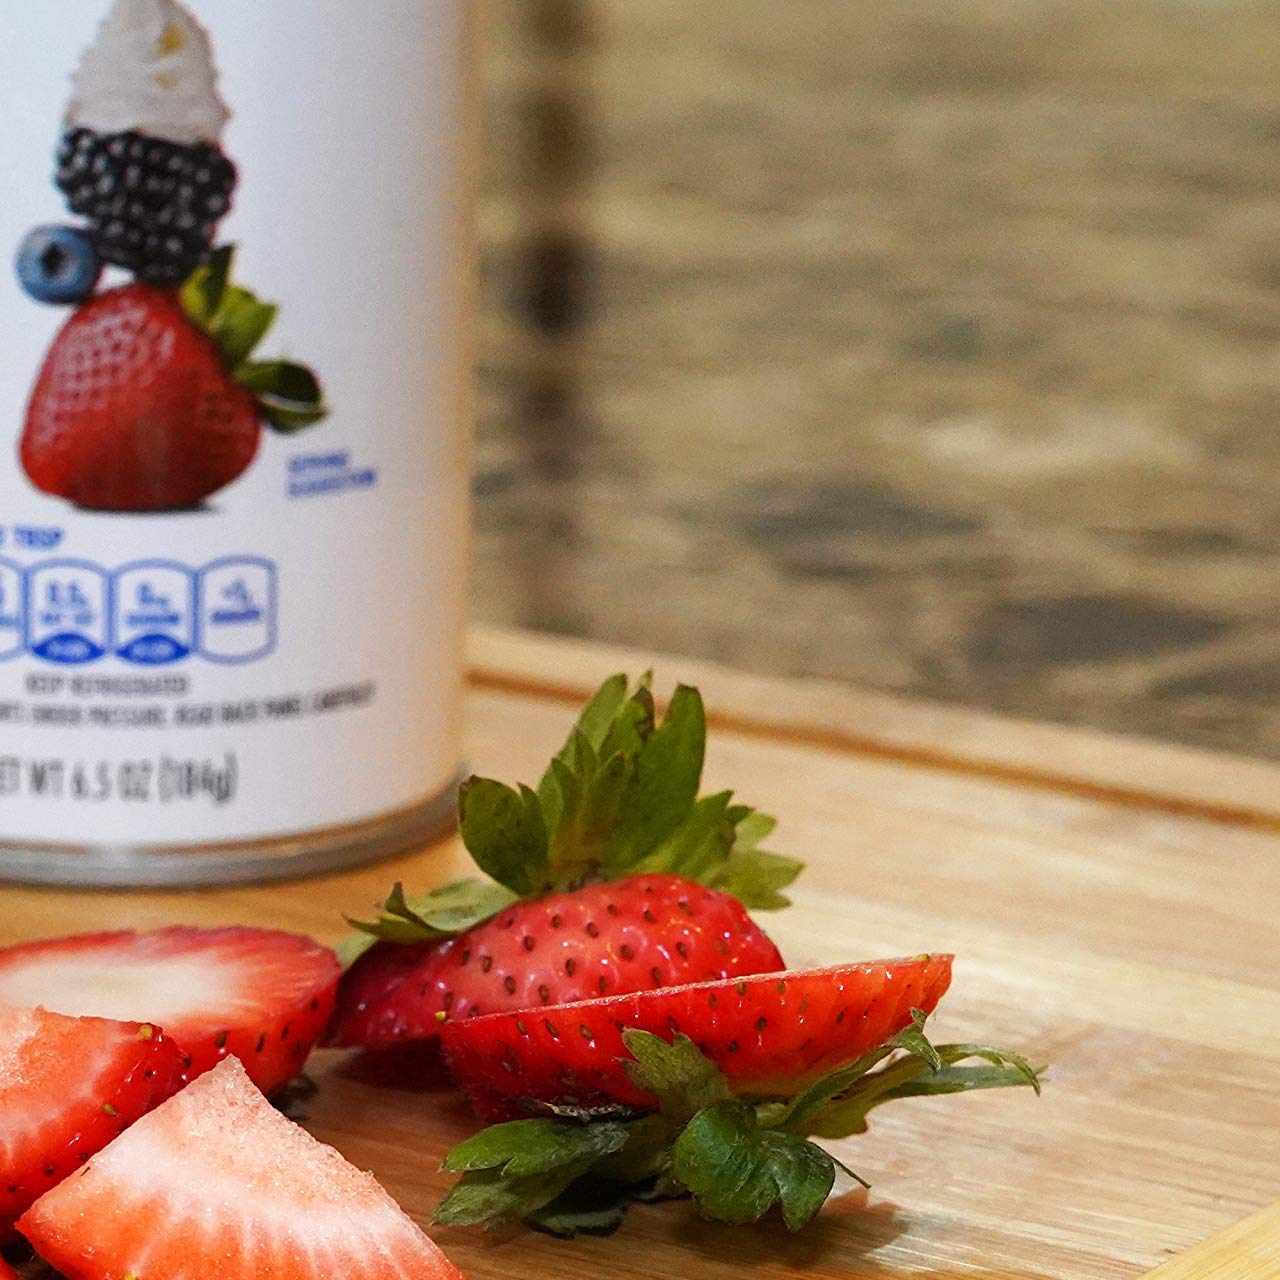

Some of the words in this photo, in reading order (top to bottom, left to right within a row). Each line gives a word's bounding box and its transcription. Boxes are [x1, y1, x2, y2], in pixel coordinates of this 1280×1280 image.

[27, 758, 65, 797] WT
[70, 759, 113, 800] 6.5
[118, 759, 153, 802] OZ
